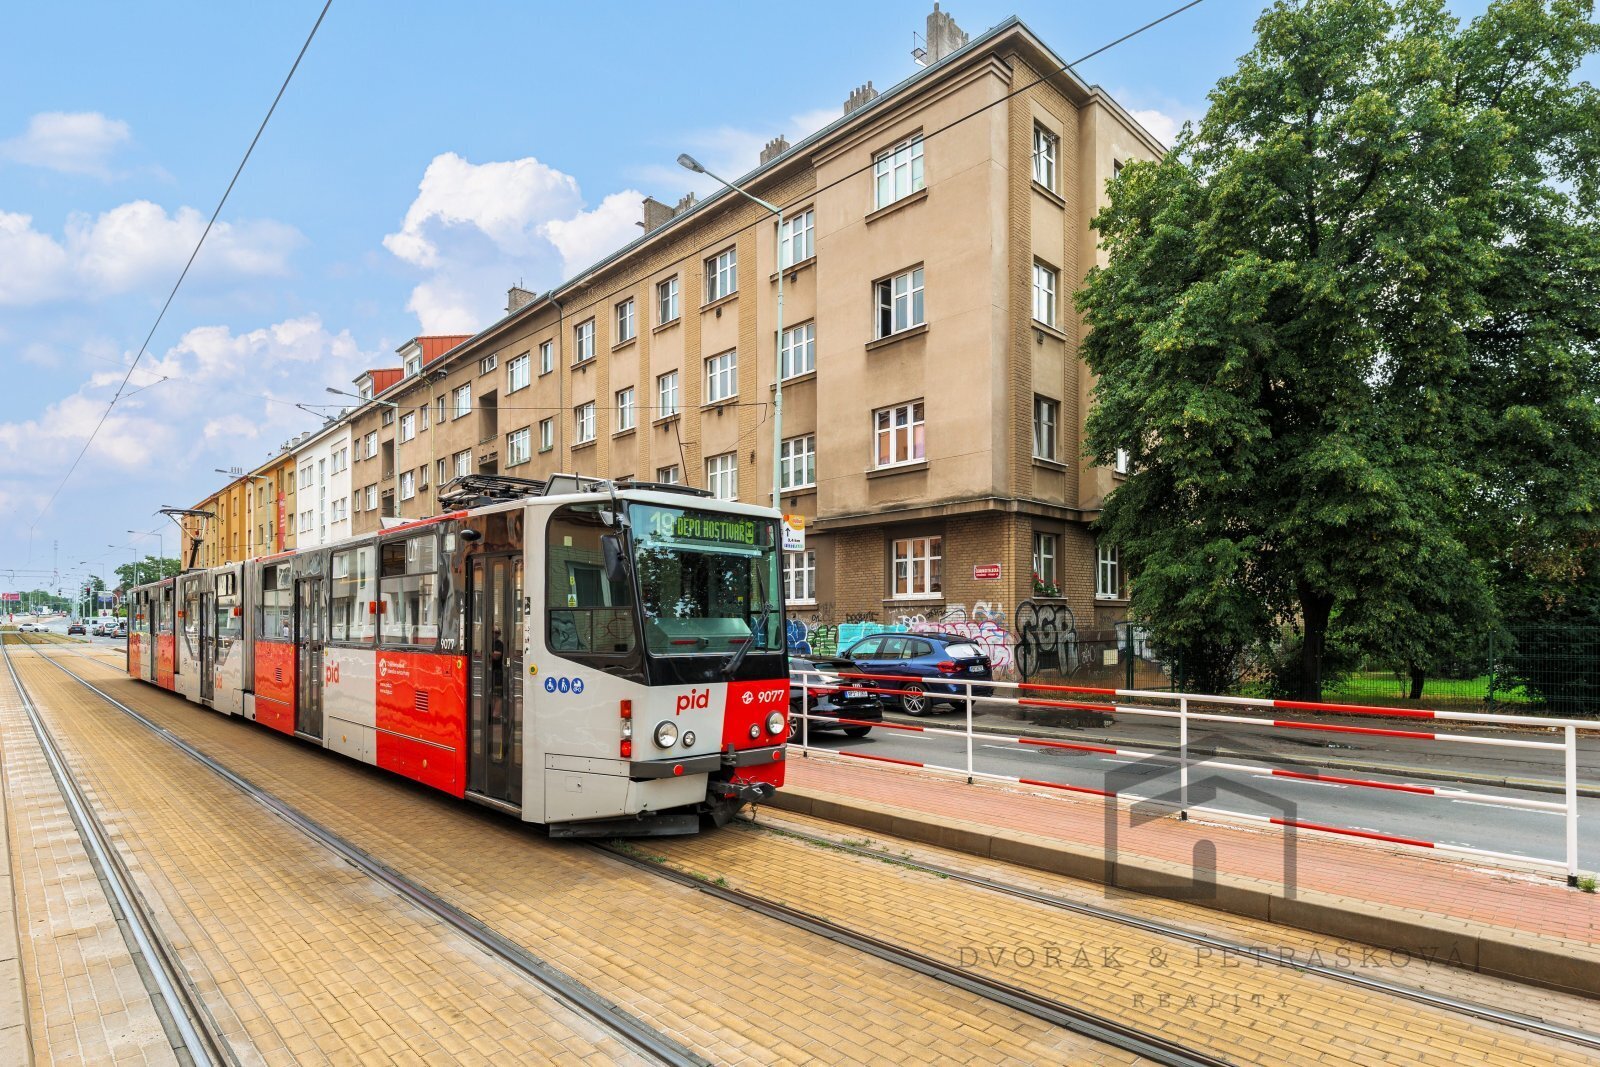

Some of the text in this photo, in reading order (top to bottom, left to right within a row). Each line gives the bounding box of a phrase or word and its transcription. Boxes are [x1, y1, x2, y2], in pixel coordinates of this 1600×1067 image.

[650, 511, 674, 537] 19
[677, 517, 700, 536] DEPO
[703, 519, 745, 541] HOSTIVAŘ
[440, 638, 455, 650] 9077
[326, 660, 339, 687] pid
[676, 688, 710, 716] pid
[758, 690, 784, 703] 9077
